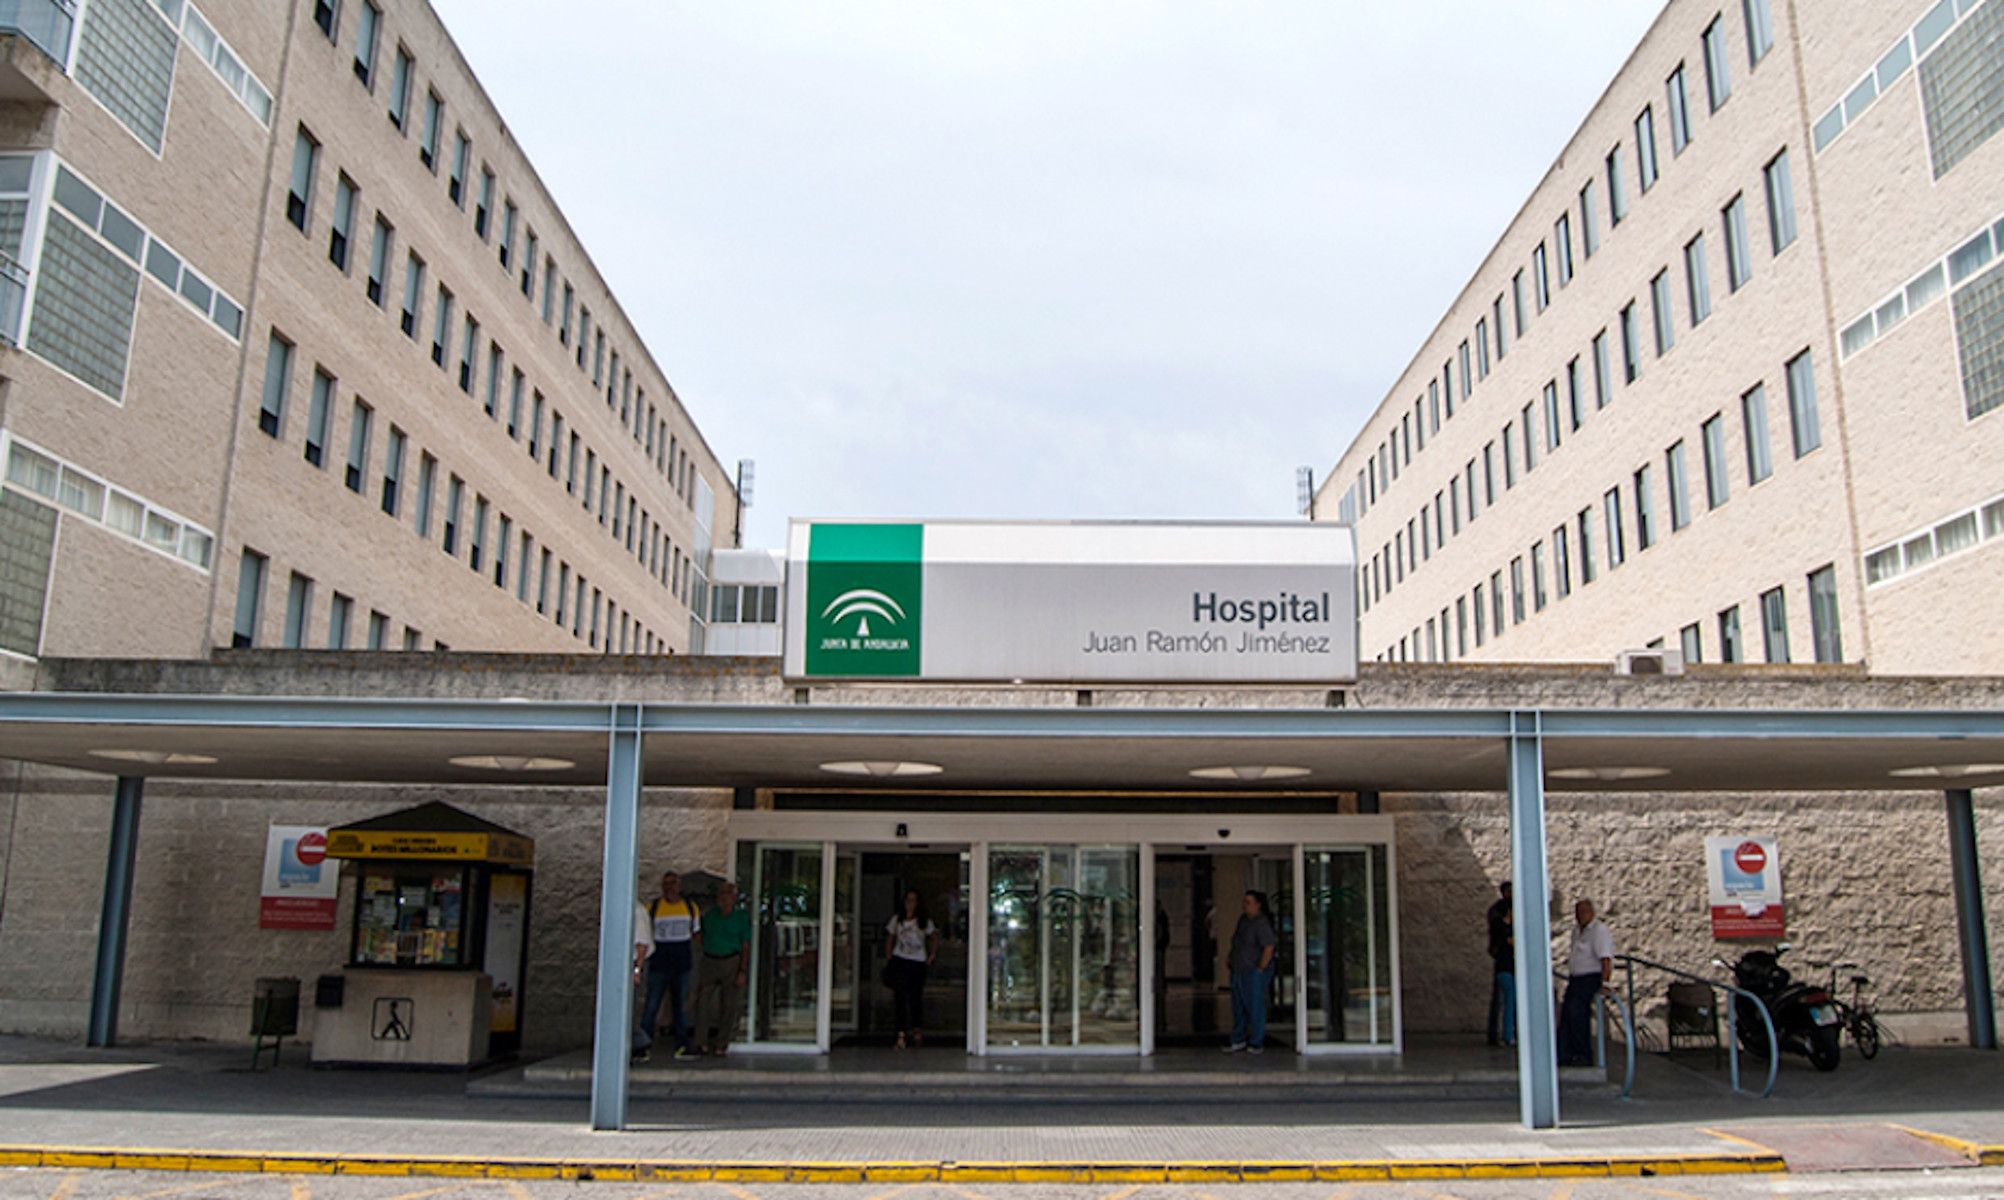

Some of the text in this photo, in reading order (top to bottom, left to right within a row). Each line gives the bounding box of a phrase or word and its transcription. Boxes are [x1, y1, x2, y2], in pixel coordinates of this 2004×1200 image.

[1192, 592, 1330, 630] Hospital
[820, 637, 848, 650] JUNTA
[850, 637, 861, 650] DE
[1082, 630, 1331, 653] Juan Ramón Jiménez
